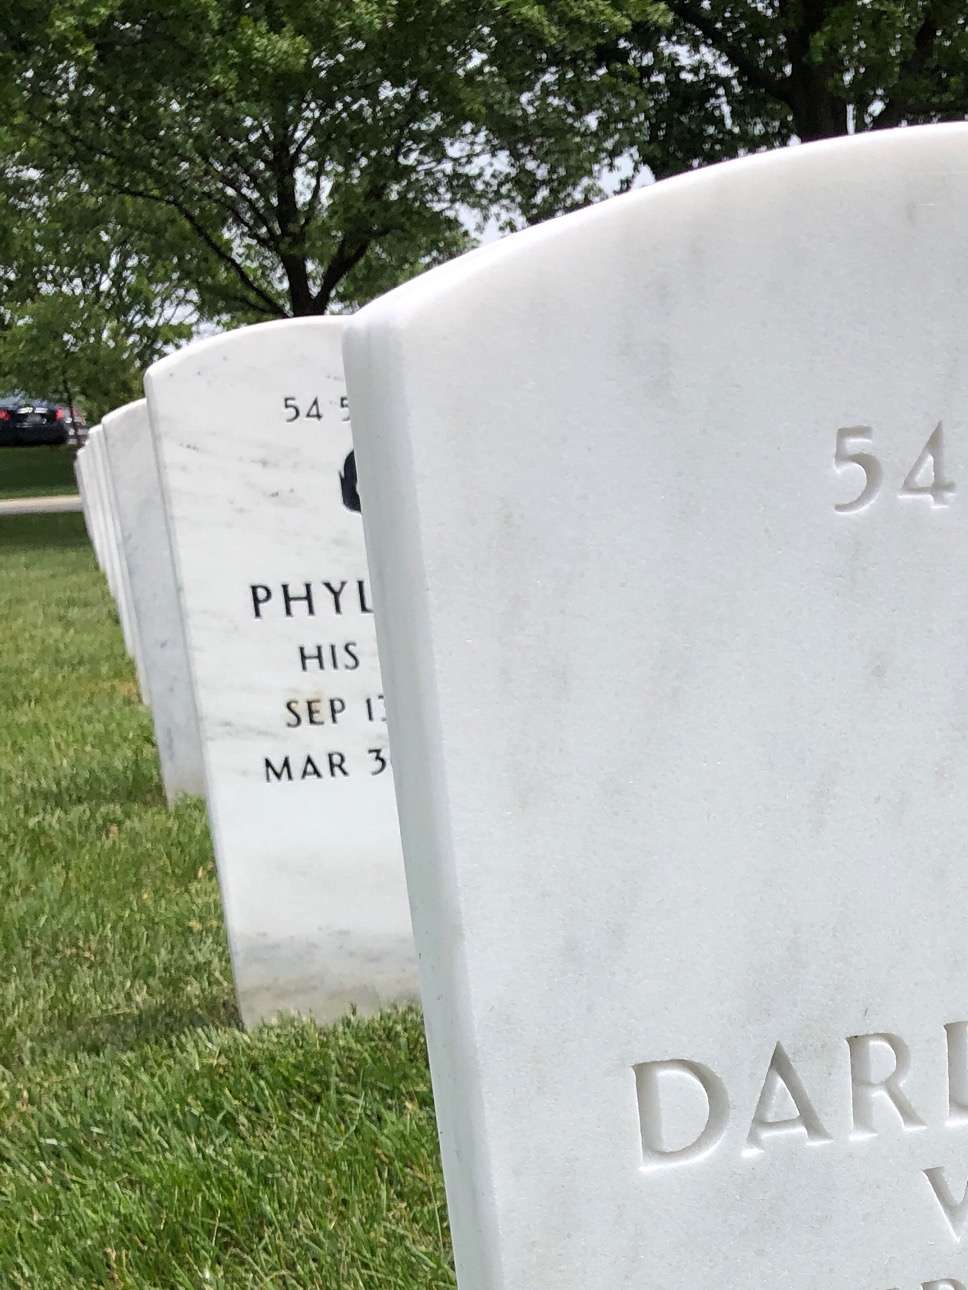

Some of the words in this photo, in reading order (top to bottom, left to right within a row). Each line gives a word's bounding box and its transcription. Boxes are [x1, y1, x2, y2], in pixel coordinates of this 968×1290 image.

[283, 396, 324, 423] 54
[833, 420, 957, 514] 54
[298, 642, 360, 672] HIS
[285, 697, 346, 728] SEP
[365, 695, 387, 723] 1
[264, 751, 349, 783] MAR
